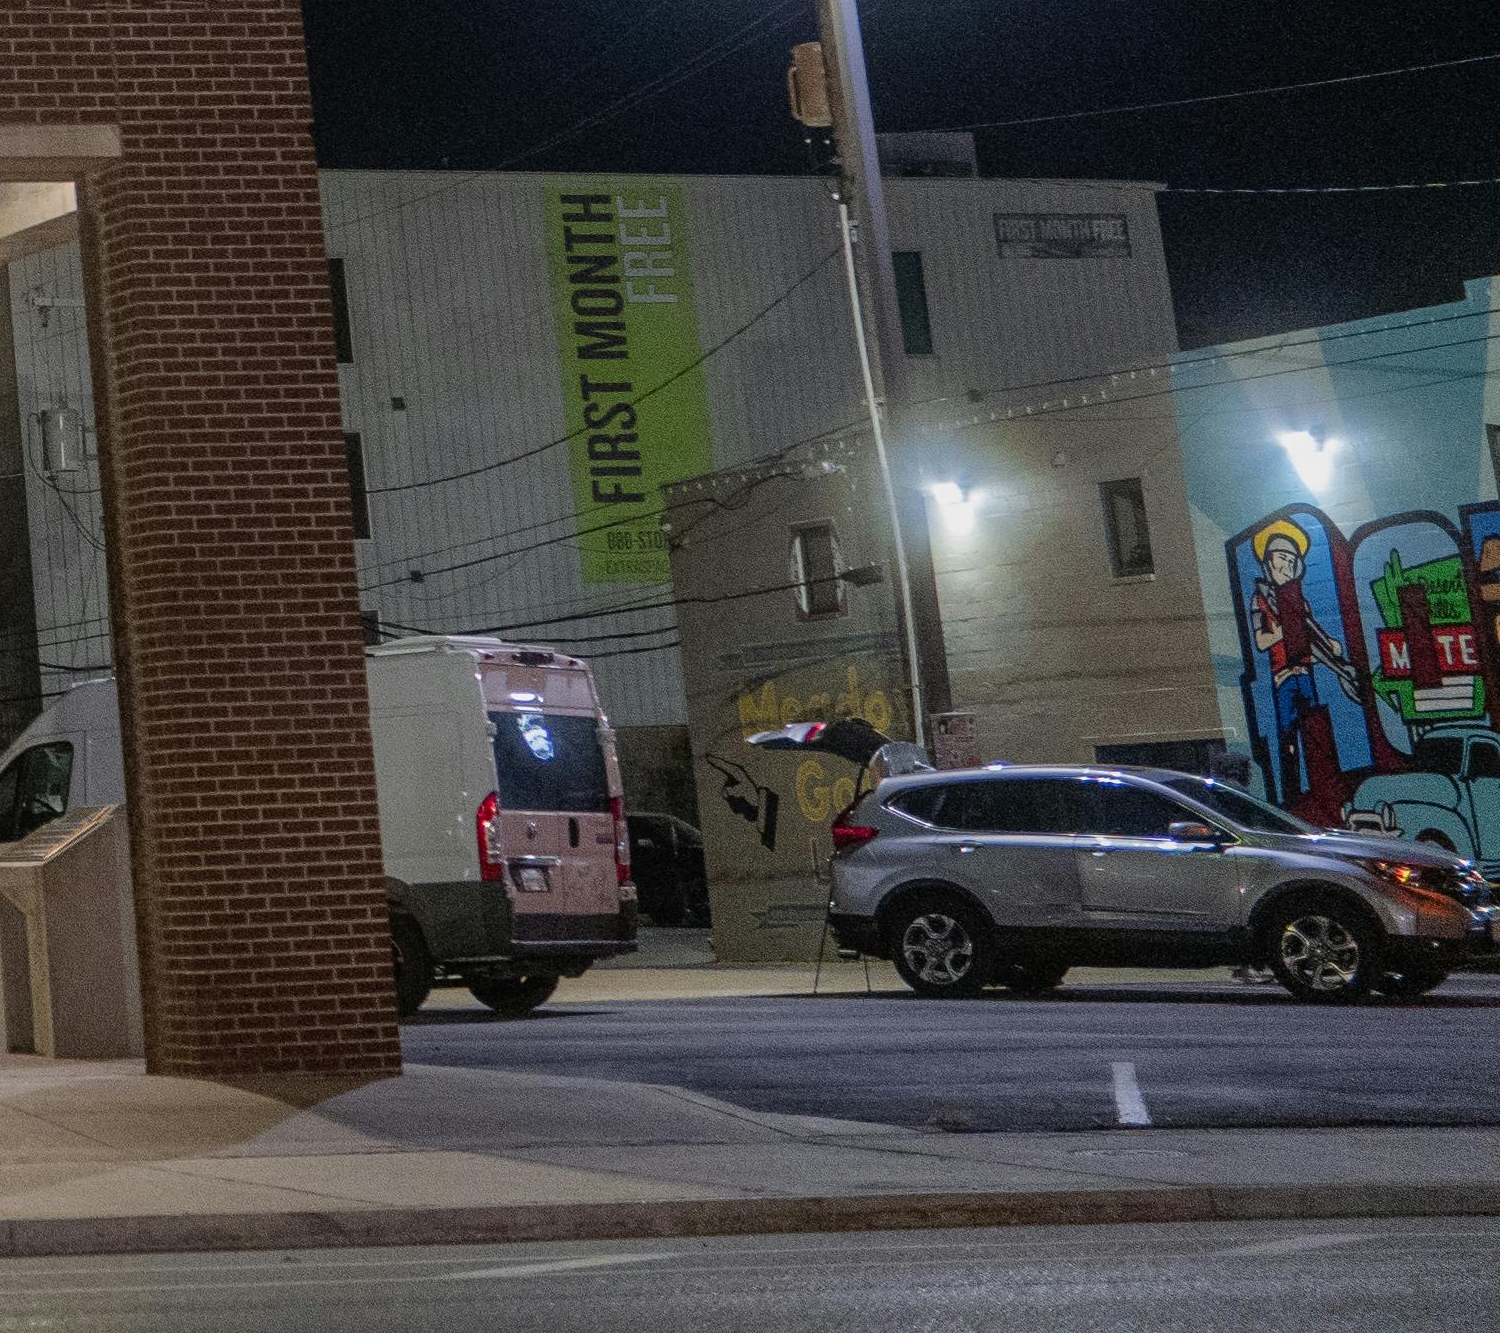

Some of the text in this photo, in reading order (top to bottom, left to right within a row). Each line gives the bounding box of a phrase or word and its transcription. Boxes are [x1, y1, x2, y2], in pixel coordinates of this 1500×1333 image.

[616, 195, 678, 304] FREE
[1092, 219, 1125, 241] FREE
[560, 194, 646, 504] FIRST MONTH
